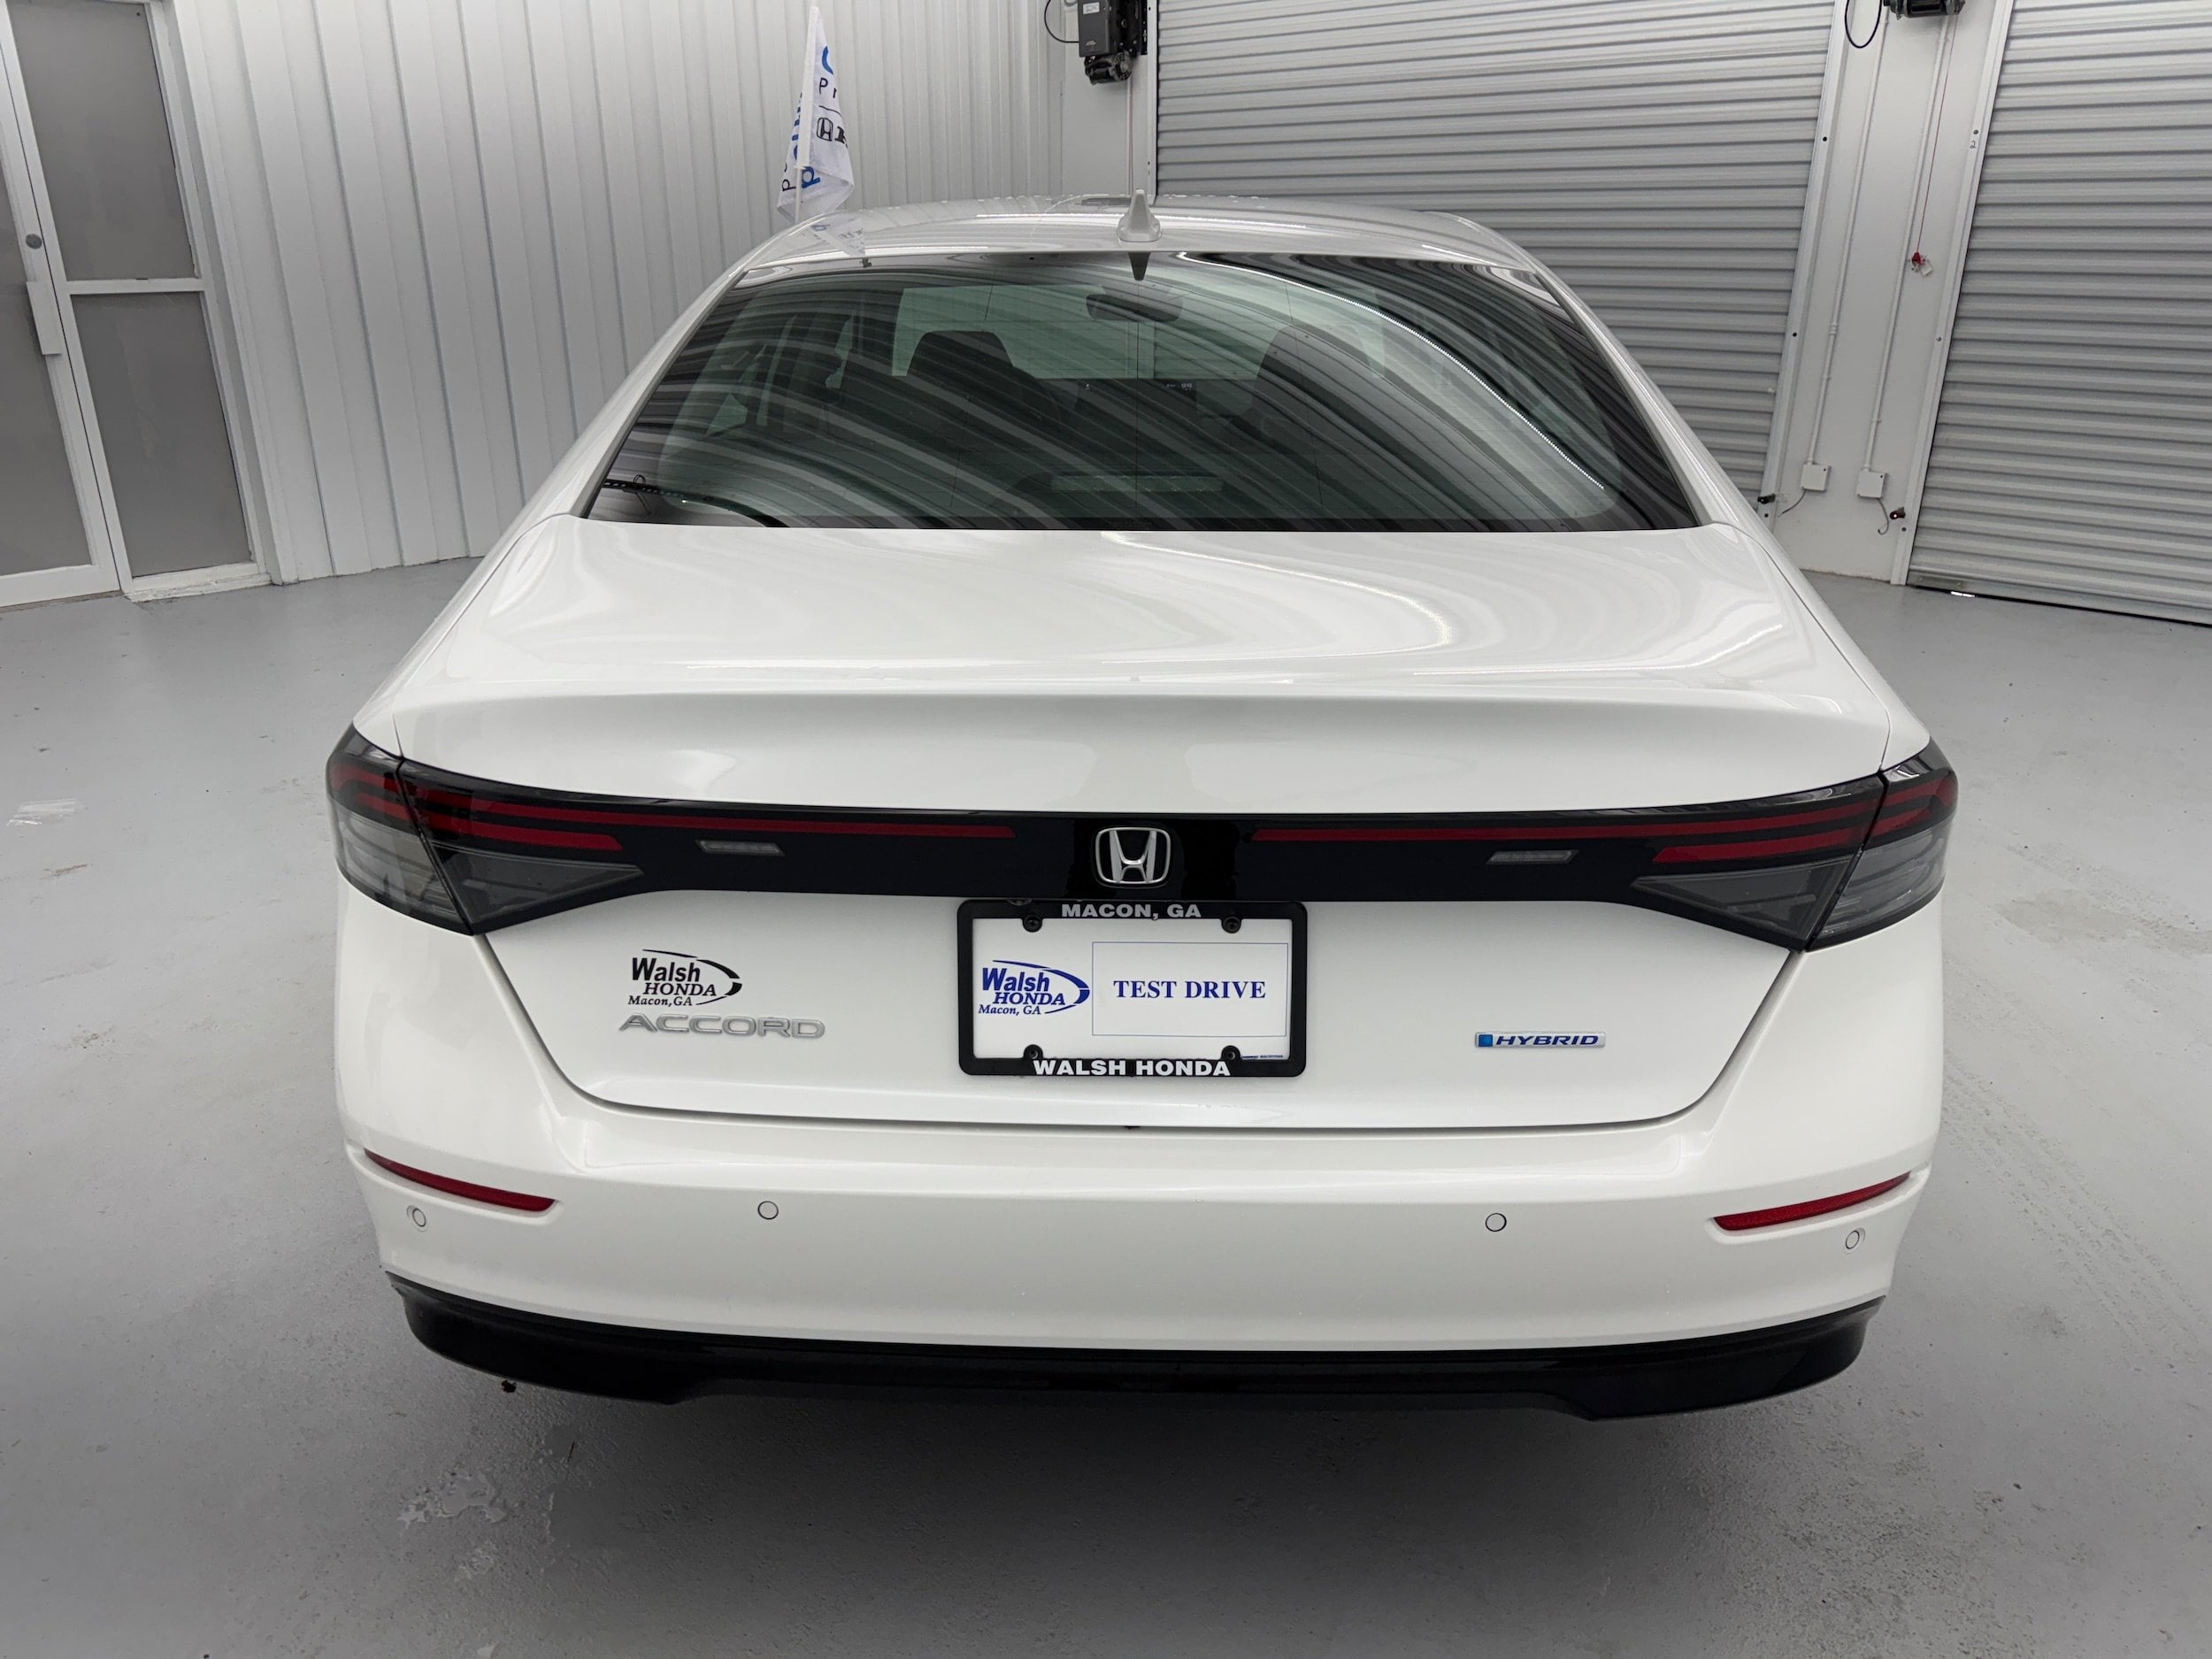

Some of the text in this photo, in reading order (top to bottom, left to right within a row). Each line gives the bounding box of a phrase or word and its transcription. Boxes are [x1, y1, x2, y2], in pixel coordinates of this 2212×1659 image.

[1062, 904, 1202, 920] MACON, GA
[632, 957, 701, 982] Walsh
[982, 968, 1050, 993] Walsh
[642, 983, 717, 996] HONDA
[1113, 980, 1267, 999] TEST DRIVE
[992, 992, 1066, 1006] HONDA
[978, 1004, 1041, 1017] Macon, GA
[618, 1012, 826, 1039] ACCORD
[1495, 1035, 1599, 1046] HYBRID
[1033, 1060, 1231, 1076] WALSH HONDA
